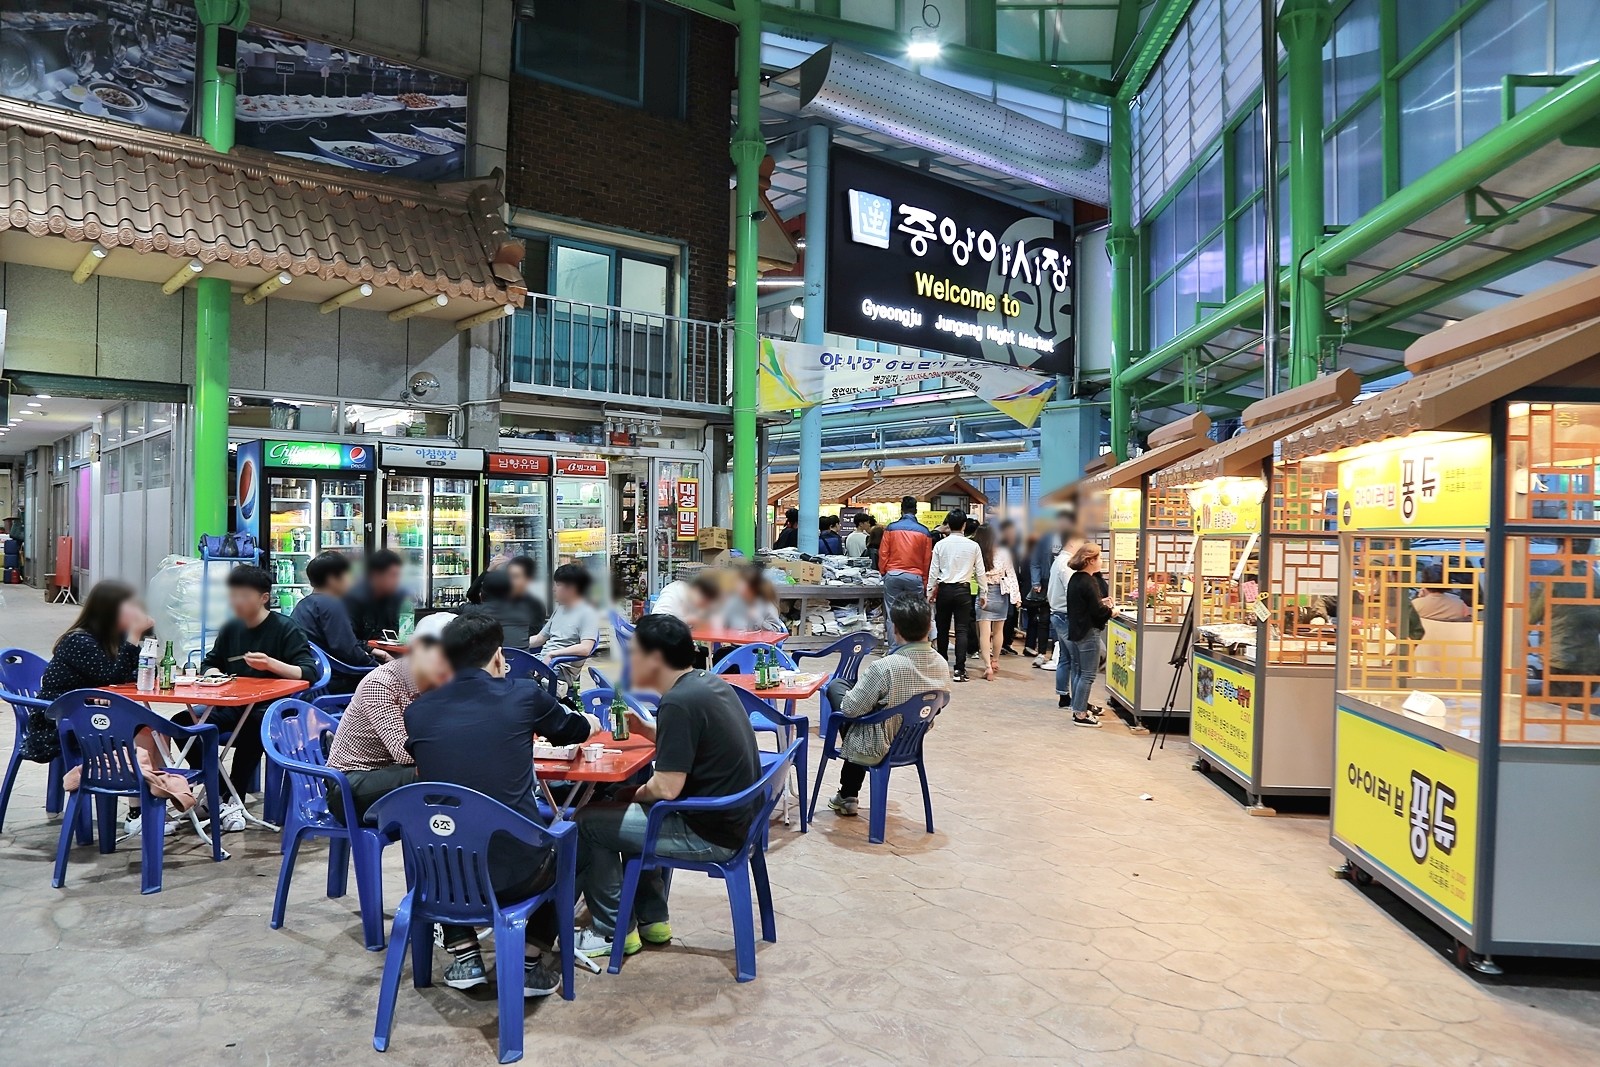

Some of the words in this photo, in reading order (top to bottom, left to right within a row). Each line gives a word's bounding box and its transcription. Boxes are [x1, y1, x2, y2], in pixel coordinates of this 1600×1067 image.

[898, 203, 1071, 293] 중앙야시장
[915, 270, 996, 313] Welcome
[1002, 292, 1021, 317] to
[861, 298, 922, 328] Gyeongju
[934, 315, 984, 342] Jungang
[987, 325, 1016, 345] Night
[1018, 333, 1055, 353] Market
[416, 449, 457, 460] 아침햇살
[498, 458, 539, 469] 남양유업
[1355, 486, 1395, 507] 아이러브
[1402, 457, 1436, 518] 퐁듀
[432, 819, 451, 831] 6조
[1348, 763, 1404, 818] 아이러브
[1410, 769, 1456, 864] 퐁듀
